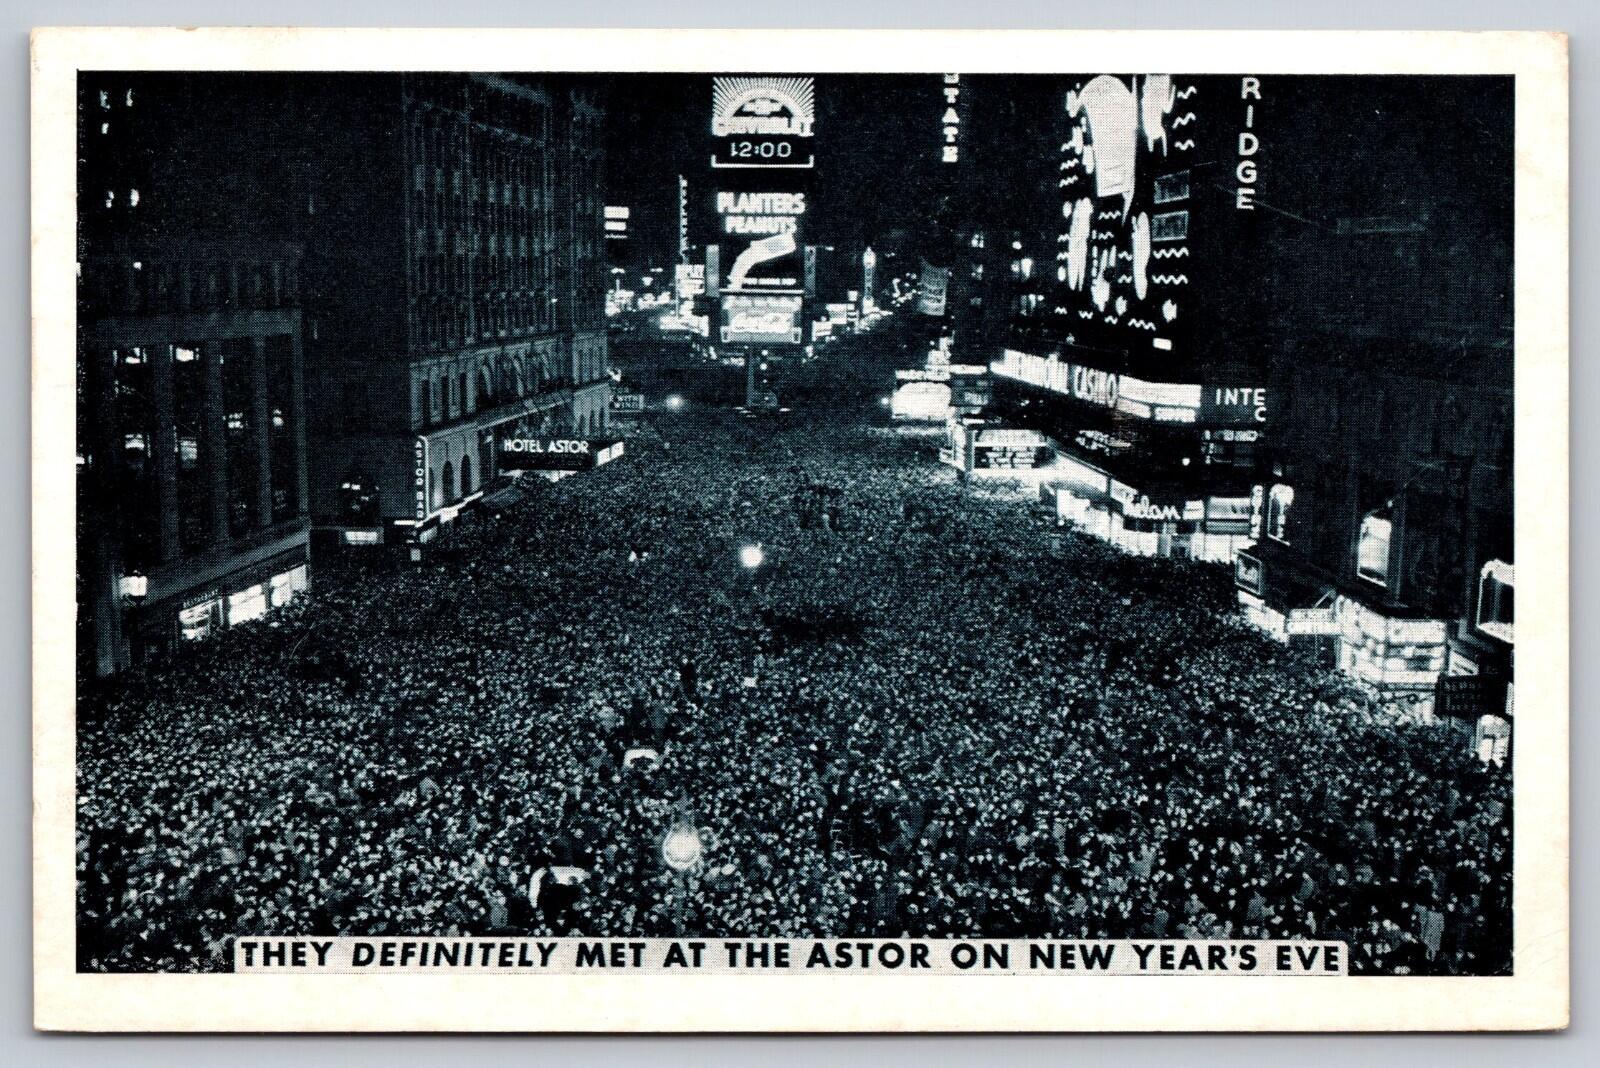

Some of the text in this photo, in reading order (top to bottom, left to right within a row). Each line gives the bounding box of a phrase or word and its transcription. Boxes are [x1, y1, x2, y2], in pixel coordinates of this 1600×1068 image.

[730, 142, 792, 158] 12:00
[716, 191, 807, 214] PLANTERS
[724, 215, 798, 234] PEANUTS
[1074, 365, 1118, 409] CASINO
[1215, 387, 1267, 406] INTE
[503, 438, 590, 454] HOTEL ASTOR
[414, 440, 425, 519] ASTOR BAR
